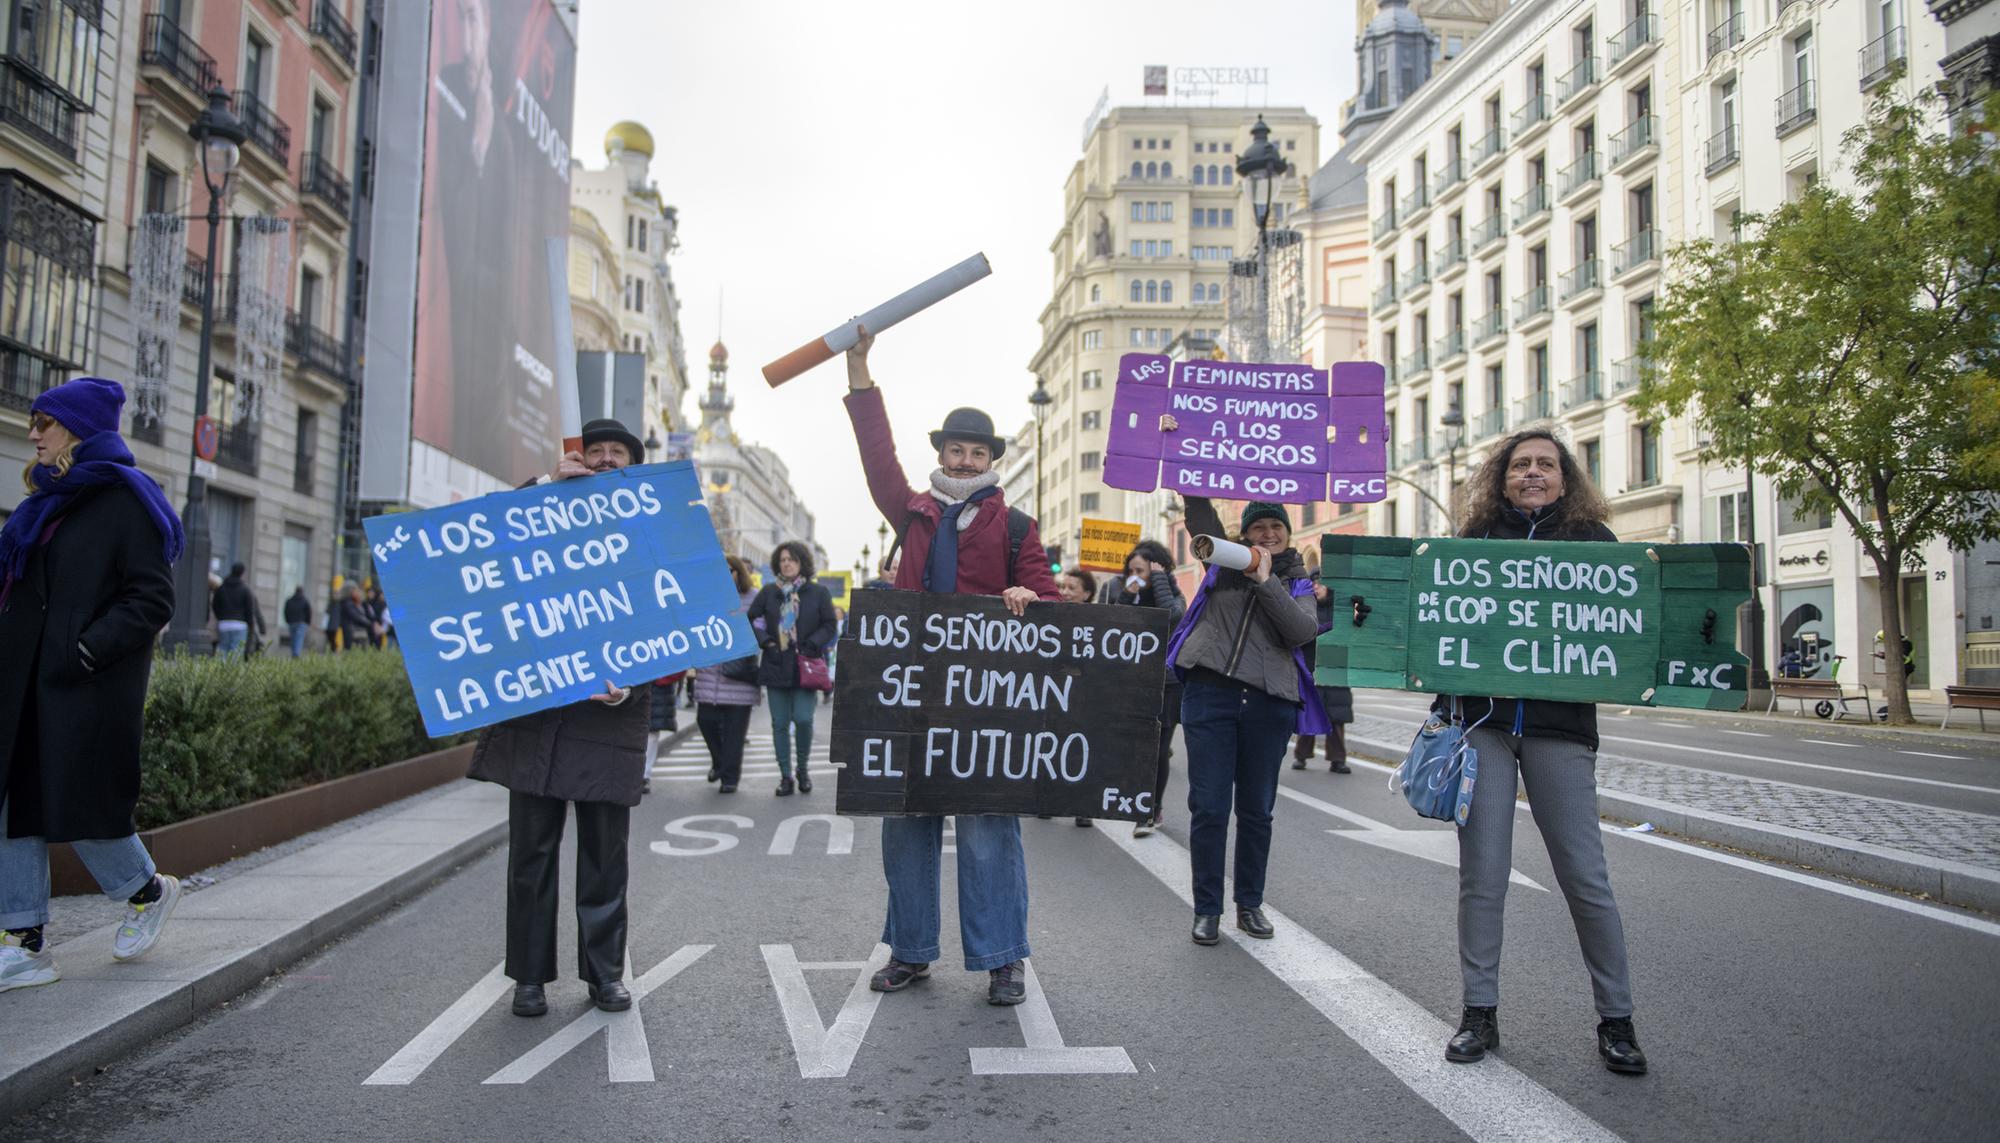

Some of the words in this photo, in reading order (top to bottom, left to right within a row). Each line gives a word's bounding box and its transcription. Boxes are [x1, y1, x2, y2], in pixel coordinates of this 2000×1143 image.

[1174, 67, 1269, 85] GENERALI
[516, 78, 569, 182] TUDOR
[1131, 361, 1165, 381] LAS
[1184, 366, 1314, 390] FEMINISTAS
[1174, 394, 1217, 412] NOS
[1225, 399, 1318, 420] FUMAMOS
[1212, 421, 1226, 437] A
[1239, 422, 1281, 440] LOS
[1179, 439, 1316, 465] SEÑOROS
[1179, 469, 1202, 486] DE
[1209, 473, 1234, 489] LA
[1245, 476, 1298, 495] COP
[1334, 479, 1385, 496] FxC
[419, 514, 495, 557] LOS
[506, 481, 661, 540] SEÑOROS
[374, 526, 410, 561] FxC
[461, 561, 504, 592] DE
[512, 550, 555, 581] LA
[563, 534, 628, 569] COP
[1434, 558, 1491, 587] LOS
[1500, 556, 1637, 596] SEÑOROS
[1935, 571, 1947, 581] 29
[1419, 592, 1439, 606] DE
[1445, 596, 1497, 624] COP
[1508, 600, 1539, 627] SE
[430, 612, 493, 660] SE
[502, 582, 633, 641] FUMAN
[655, 569, 686, 608] A
[1418, 609, 1440, 622] LA
[1552, 602, 1642, 633] FUMAN
[860, 615, 910, 648] LOS
[923, 613, 1060, 657] SEÑOROS
[1073, 627, 1094, 642] DE
[1102, 629, 1159, 663] COP
[1073, 644, 1094, 658] LA
[1439, 637, 1480, 669] EL
[436, 679, 489, 720] LA
[495, 651, 595, 701] GENTE
[603, 631, 689, 673] (COMO
[691, 616, 732, 649] TÚ)
[1669, 661, 1732, 689] FxC
[879, 664, 924, 706] SE
[945, 665, 1072, 711] FUMAN
[863, 739, 903, 776] EL
[926, 728, 1088, 781] FUTURO
[1103, 788, 1151, 813] FxC
[361, 943, 1138, 1085] TAXI
